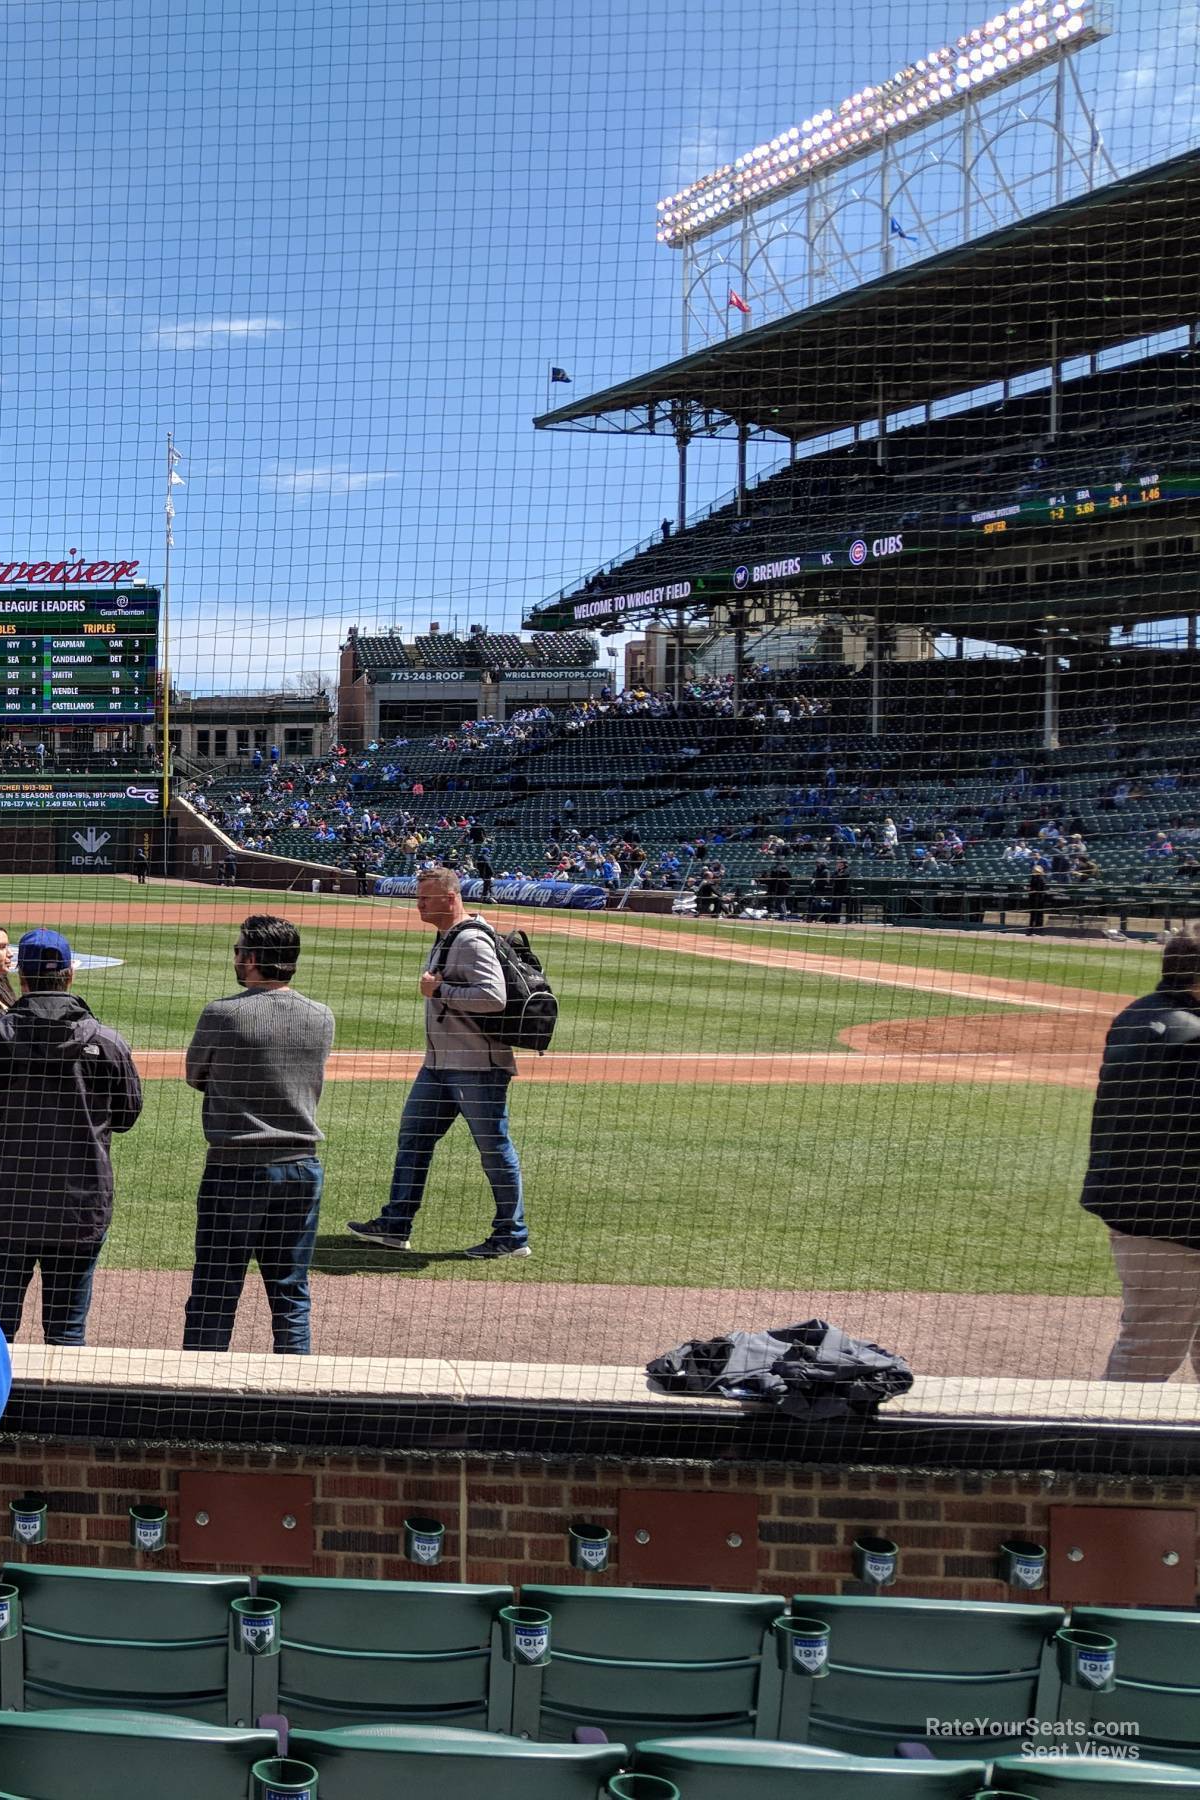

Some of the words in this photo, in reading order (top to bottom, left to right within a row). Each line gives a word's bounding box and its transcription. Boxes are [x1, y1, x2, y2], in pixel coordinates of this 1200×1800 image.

[1140, 475, 1159, 486] WHIP
[1076, 490, 1090, 500] ERA
[1140, 488, 1160, 501] 1.46
[872, 534, 903, 557] CUBS
[752, 557, 801, 582] BREWERS
[574, 602, 613, 620] WELCOME
[614, 597, 625, 611] TO
[626, 586, 665, 609] WRIGLEY
[666, 581, 691, 602] FIELD
[0, 601, 38, 612] LEAGUE
[41, 600, 85, 612] LEADERS
[83, 624, 116, 633] TRIPLES
[53, 640, 85, 648] CHAPMAN
[52, 655, 92, 663] CANDELARIO
[390, 672, 465, 681] 773-248-ROOF
[504, 671, 606, 679] WRIGLEYROOFTOPS.COM
[52, 687, 79, 695] WENDLE
[52, 702, 94, 710] CASTELLANOS
[71, 856, 113, 866] IDEAL
[518, 883, 552, 905] Wrap
[17, 1523, 37, 1531] 1914
[138, 1530, 158, 1538] 1914
[416, 1544, 436, 1553] 1914
[583, 1550, 603, 1558] 1914
[869, 1564, 890, 1573] 1914
[1019, 1567, 1039, 1576] 1914
[518, 1637, 545, 1648] 1914
[798, 1648, 824, 1659] 1914
[1082, 1662, 1109, 1673] 1914
